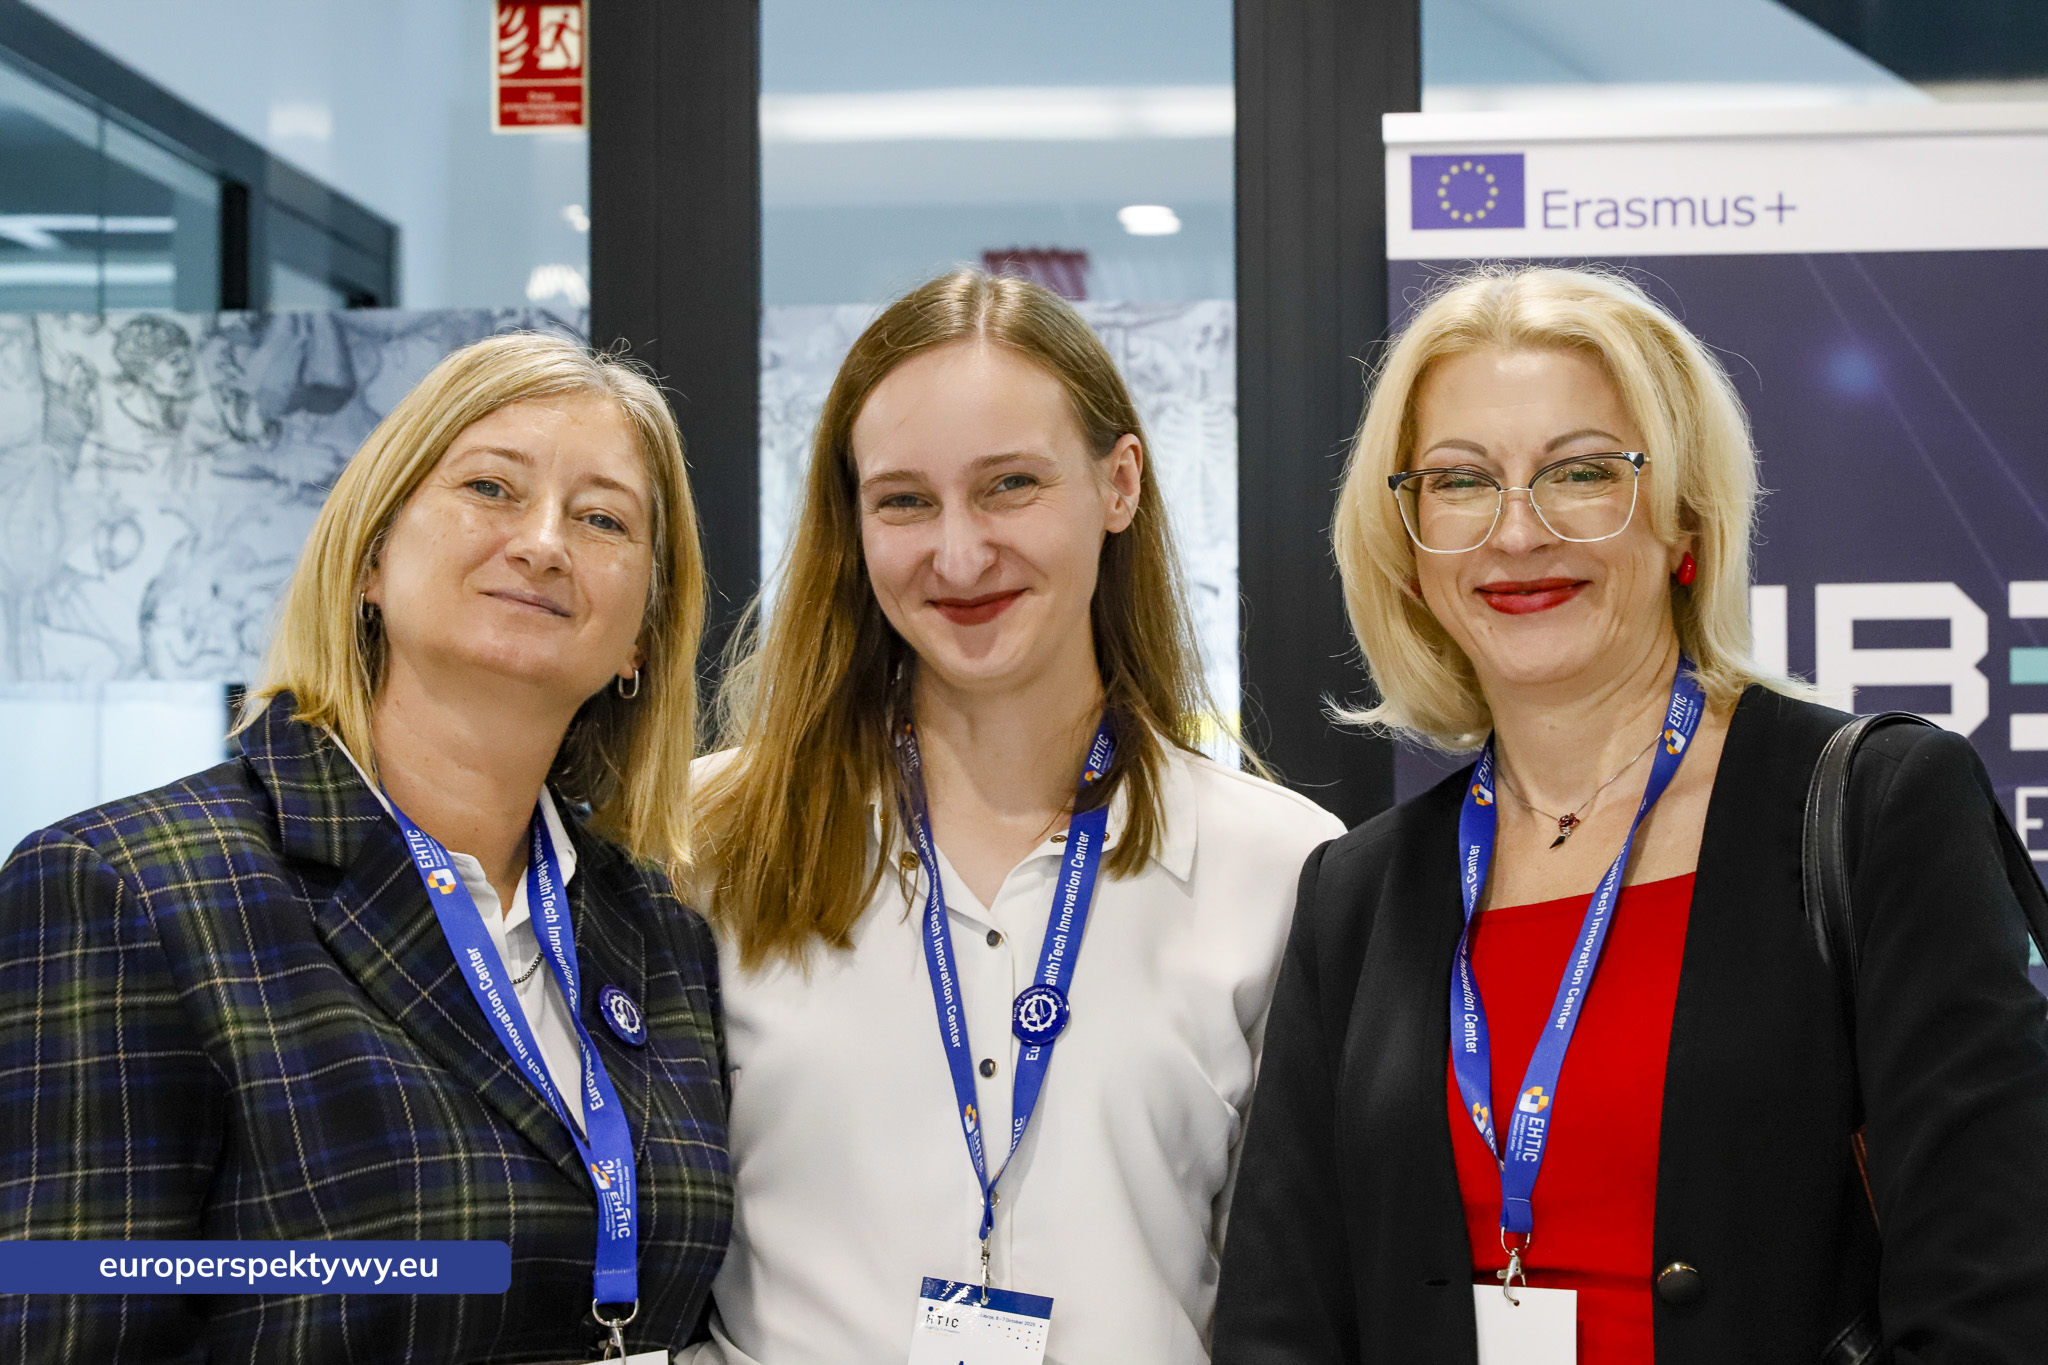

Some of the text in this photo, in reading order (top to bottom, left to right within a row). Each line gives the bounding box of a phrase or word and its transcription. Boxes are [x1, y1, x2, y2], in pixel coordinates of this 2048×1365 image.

[1542, 189, 1797, 230] Erasmus+
[1669, 693, 1688, 728] EHTIC
[1089, 734, 1109, 769] EHTIC
[406, 829, 435, 869] EHTIC
[1466, 844, 1480, 884] Center
[537, 860, 559, 924] HealthTech
[548, 925, 575, 987] Innovation
[1044, 831, 1090, 986] althTech Innovation Center
[466, 947, 494, 991] Center
[1571, 917, 1604, 986] Innovation
[934, 937, 953, 1005] Innovation
[946, 1004, 961, 1048] Center
[1555, 987, 1580, 1031] Center
[488, 988, 534, 1065] Innovation
[1464, 1012, 1479, 1054] Center
[1522, 1116, 1546, 1163] EHTIC
[610, 1191, 631, 1239] EHTIC
